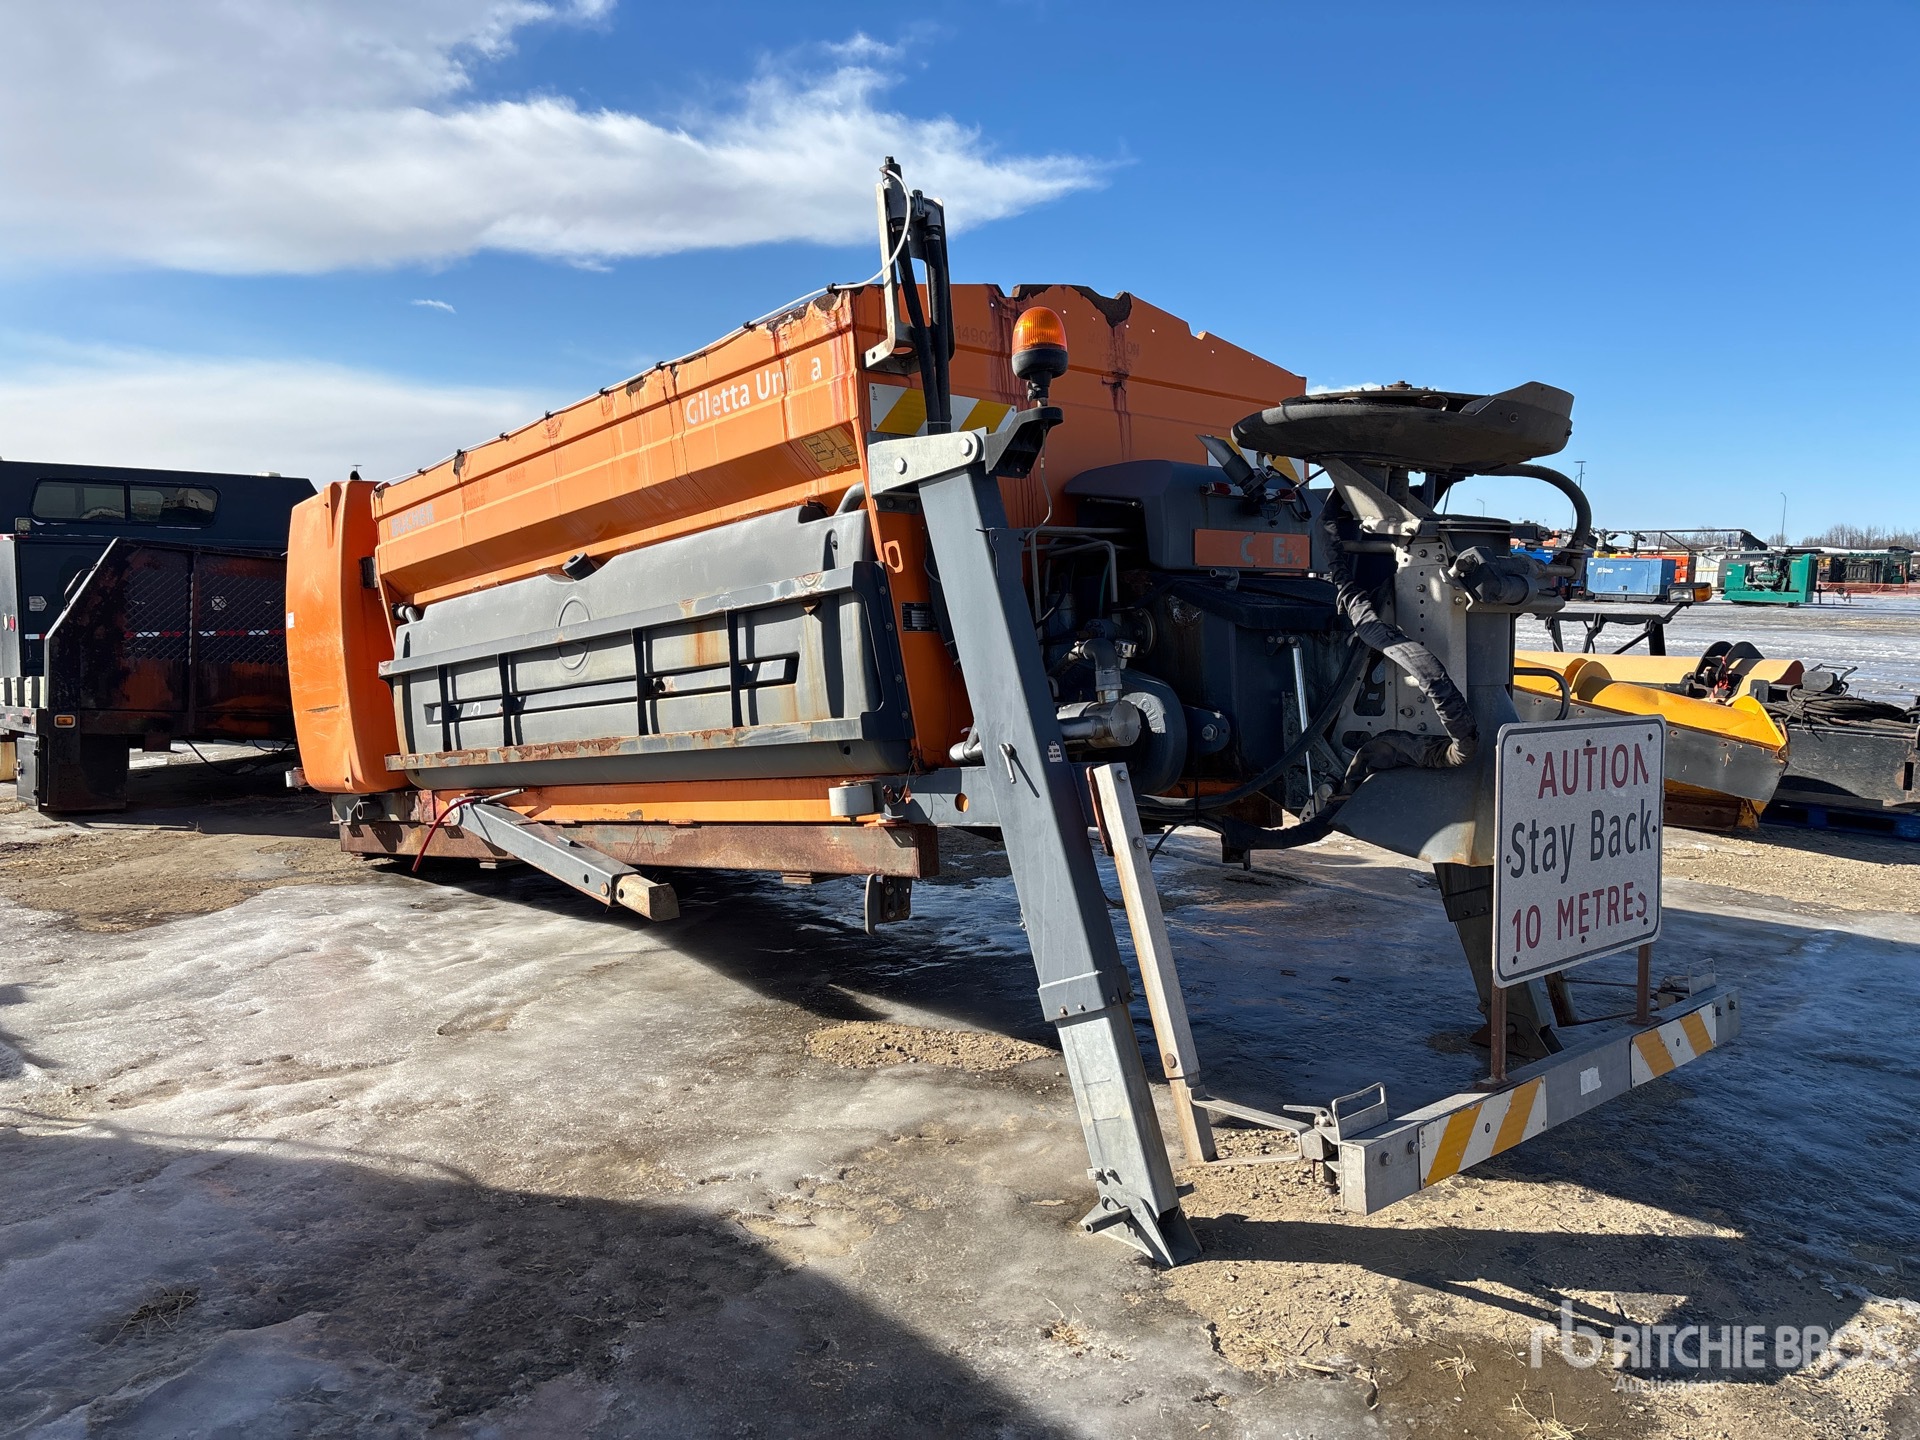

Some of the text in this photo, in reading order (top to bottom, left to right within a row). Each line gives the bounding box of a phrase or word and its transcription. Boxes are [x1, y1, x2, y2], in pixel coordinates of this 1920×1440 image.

[686, 384, 750, 425] Giletta
[391, 503, 435, 537] BUCHER
[1526, 743, 1649, 800] AUTION
[1510, 799, 1652, 884] Stay Back
[1512, 905, 1542, 953] 10
